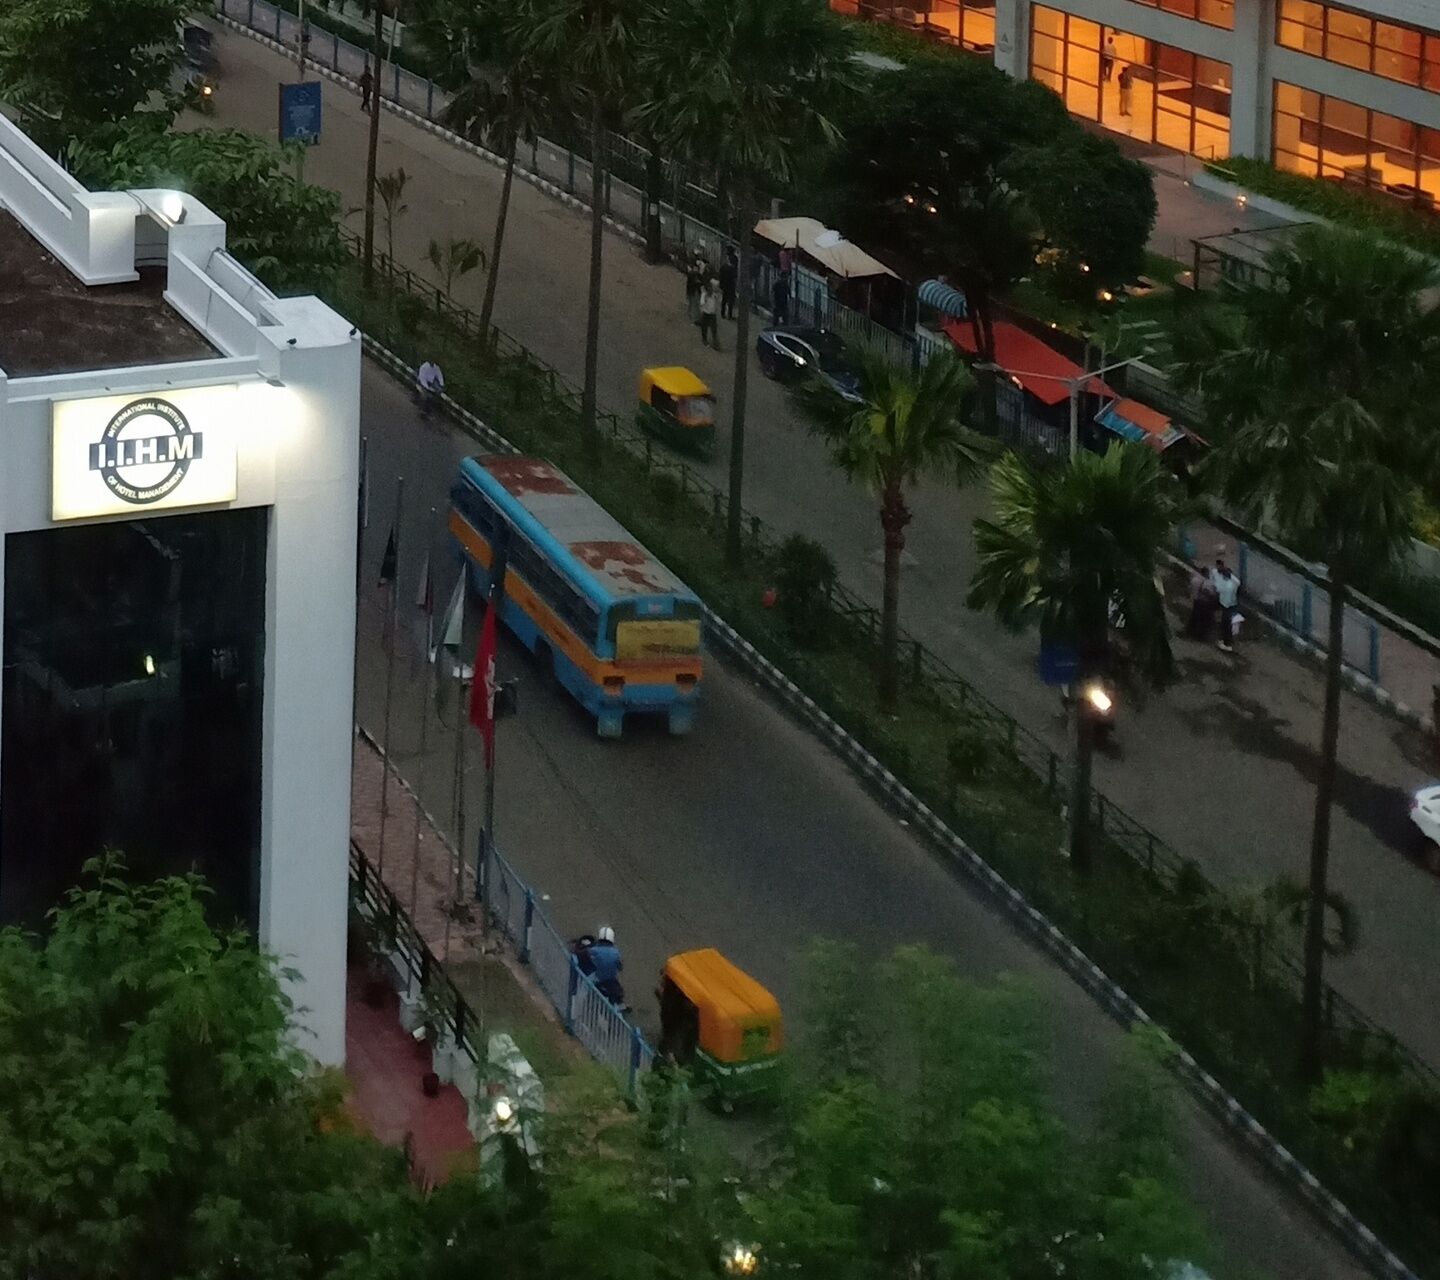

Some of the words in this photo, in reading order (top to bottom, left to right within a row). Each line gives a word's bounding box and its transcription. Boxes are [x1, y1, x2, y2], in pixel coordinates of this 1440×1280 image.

[107, 402, 156, 438] INTERNATIONAL
[157, 403, 186, 431] INSTITUTE
[98, 434, 194, 469] I.I.H.M
[107, 475, 118, 486] OF
[115, 483, 138, 499] HOTEL
[138, 467, 184, 499] MANAGEMENT
